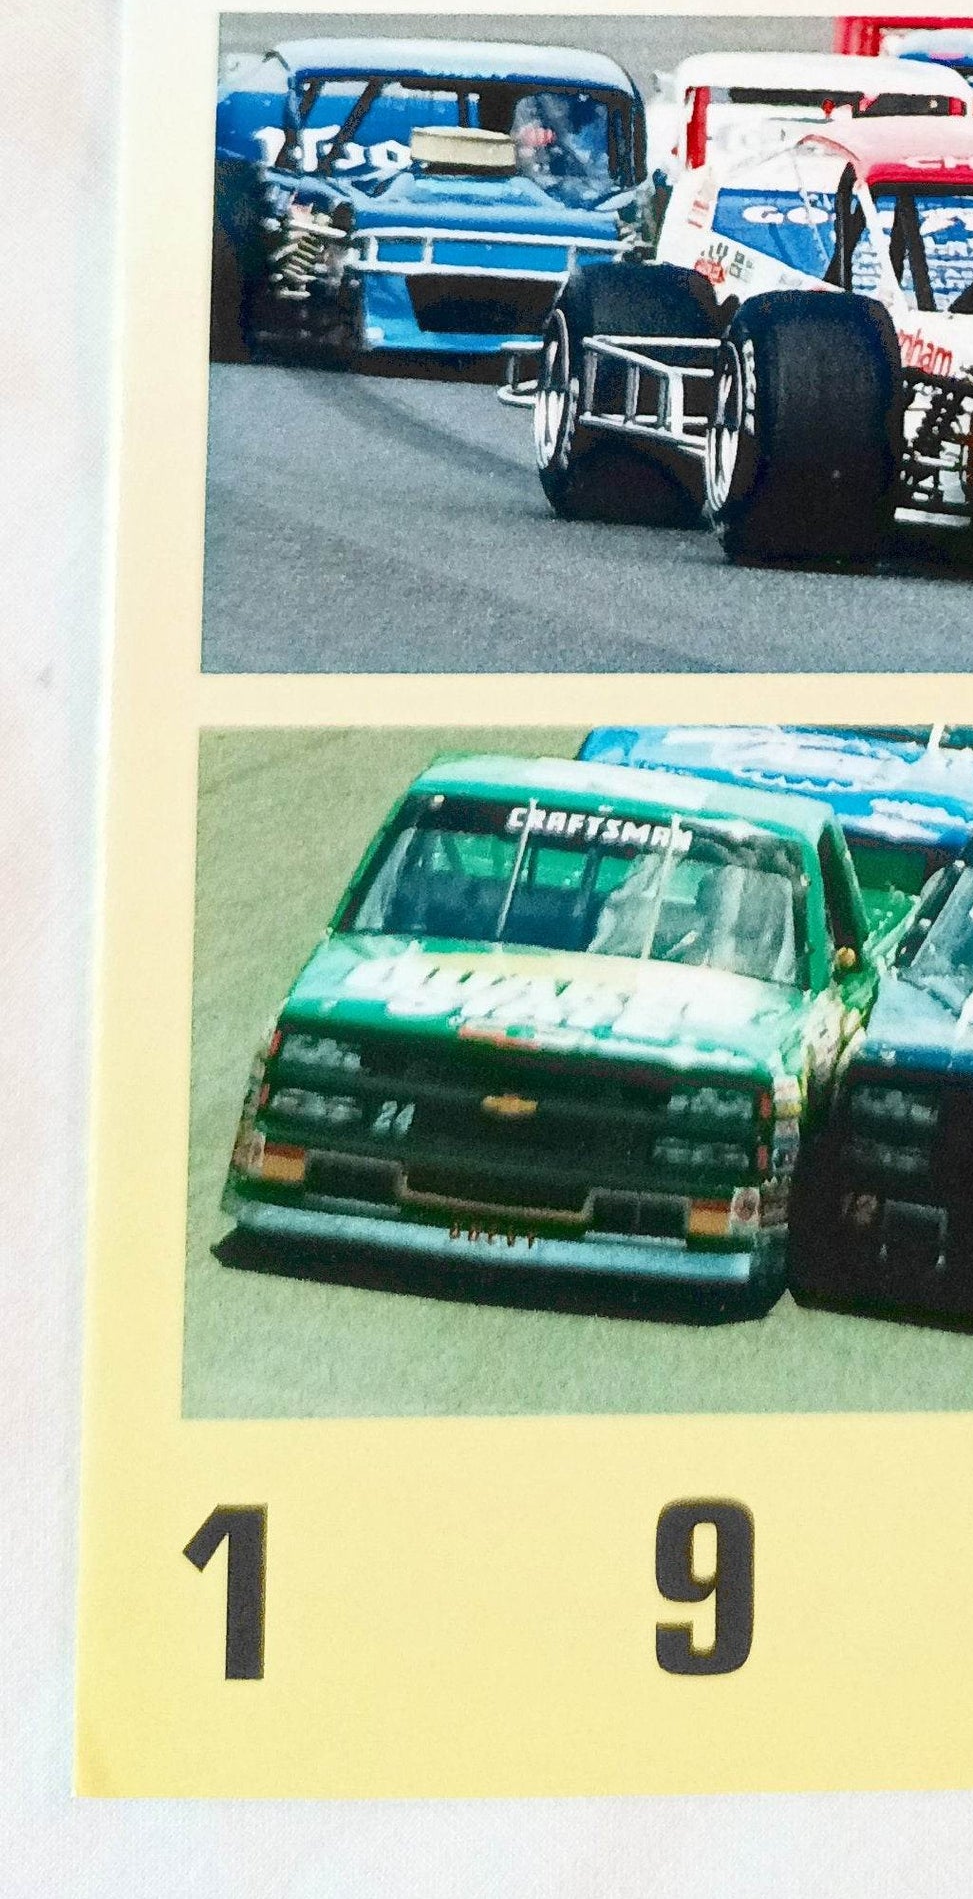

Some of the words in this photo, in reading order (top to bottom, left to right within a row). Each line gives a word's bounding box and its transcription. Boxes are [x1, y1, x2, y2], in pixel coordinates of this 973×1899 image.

[506, 806, 694, 853] CRAFTSMAN
[182, 1504, 268, 1681] 1
[655, 1499, 756, 1676] 9
